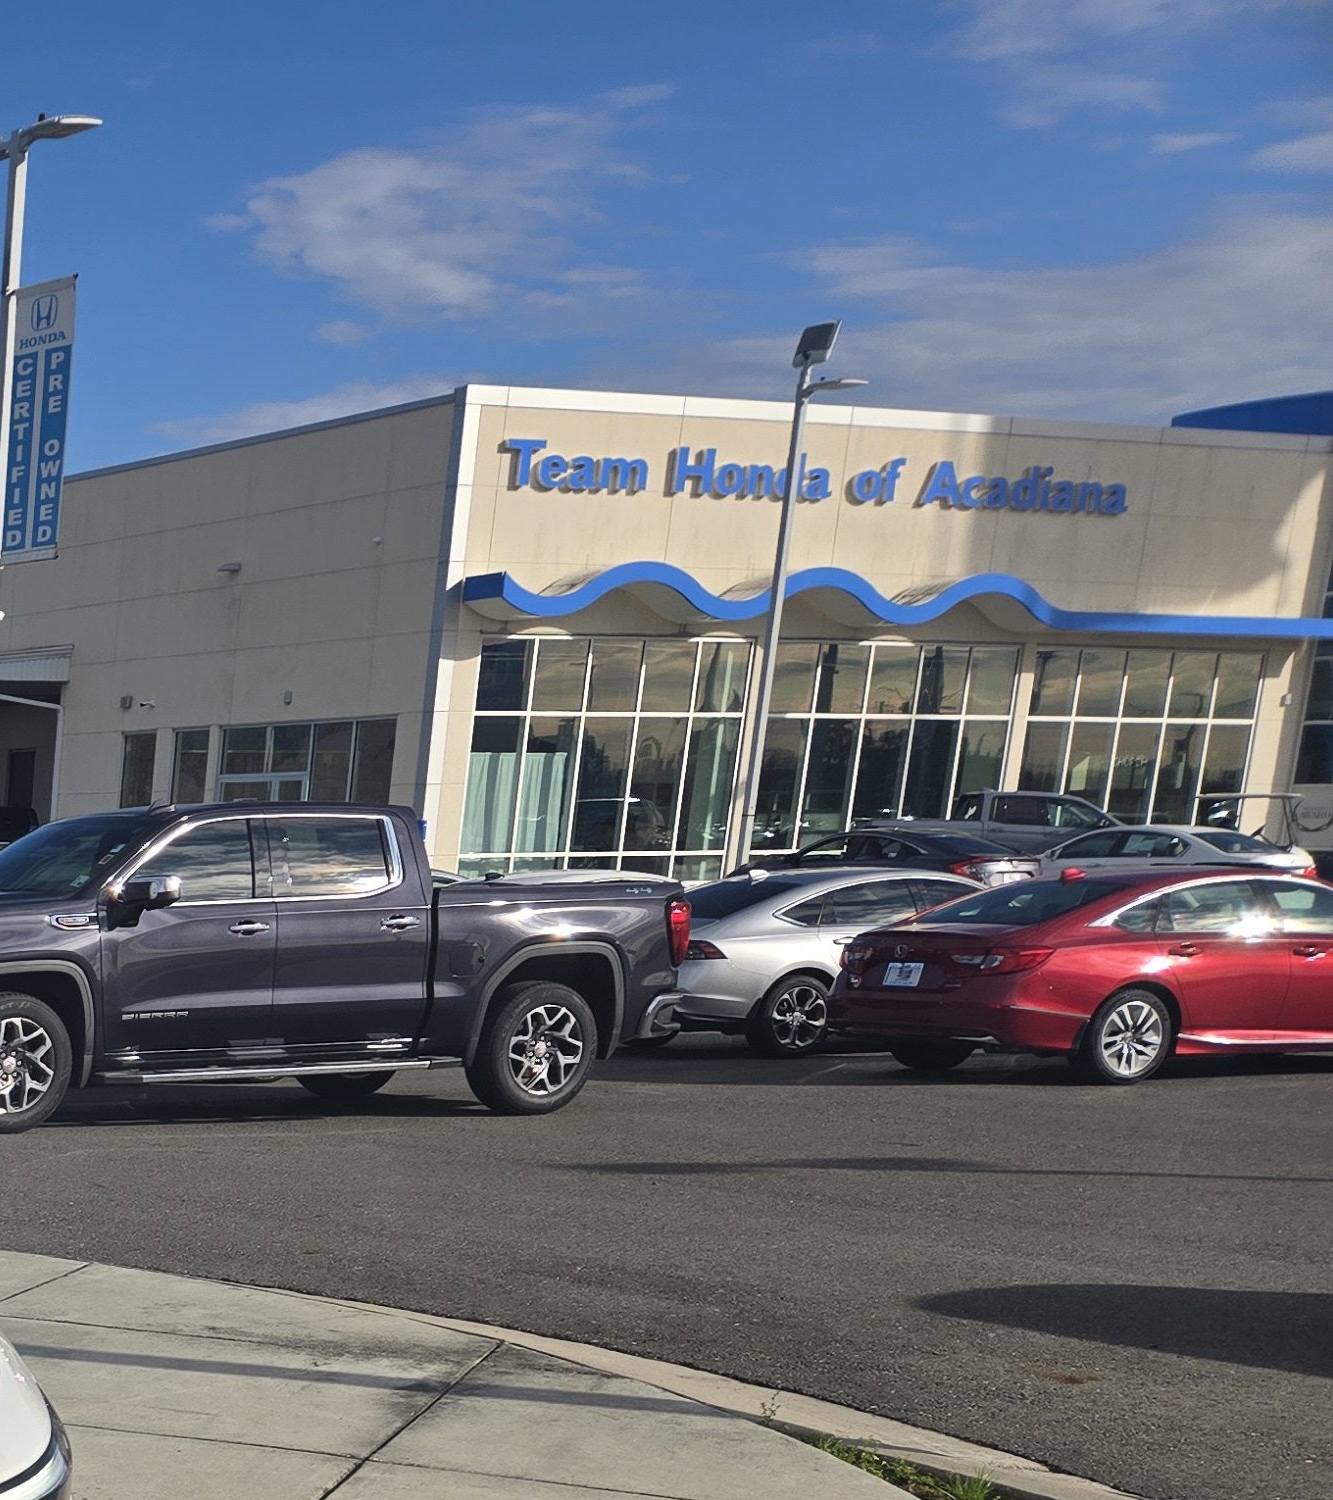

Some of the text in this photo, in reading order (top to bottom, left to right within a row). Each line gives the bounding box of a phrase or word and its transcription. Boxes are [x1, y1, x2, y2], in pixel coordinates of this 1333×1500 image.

[19, 331, 66, 350] HONDA
[6, 358, 34, 547] CERTIFIED
[37, 351, 65, 542] PRE OWNED
[504, 438, 649, 493] Team
[849, 457, 907, 504] of
[915, 460, 1129, 515] Acadiana
